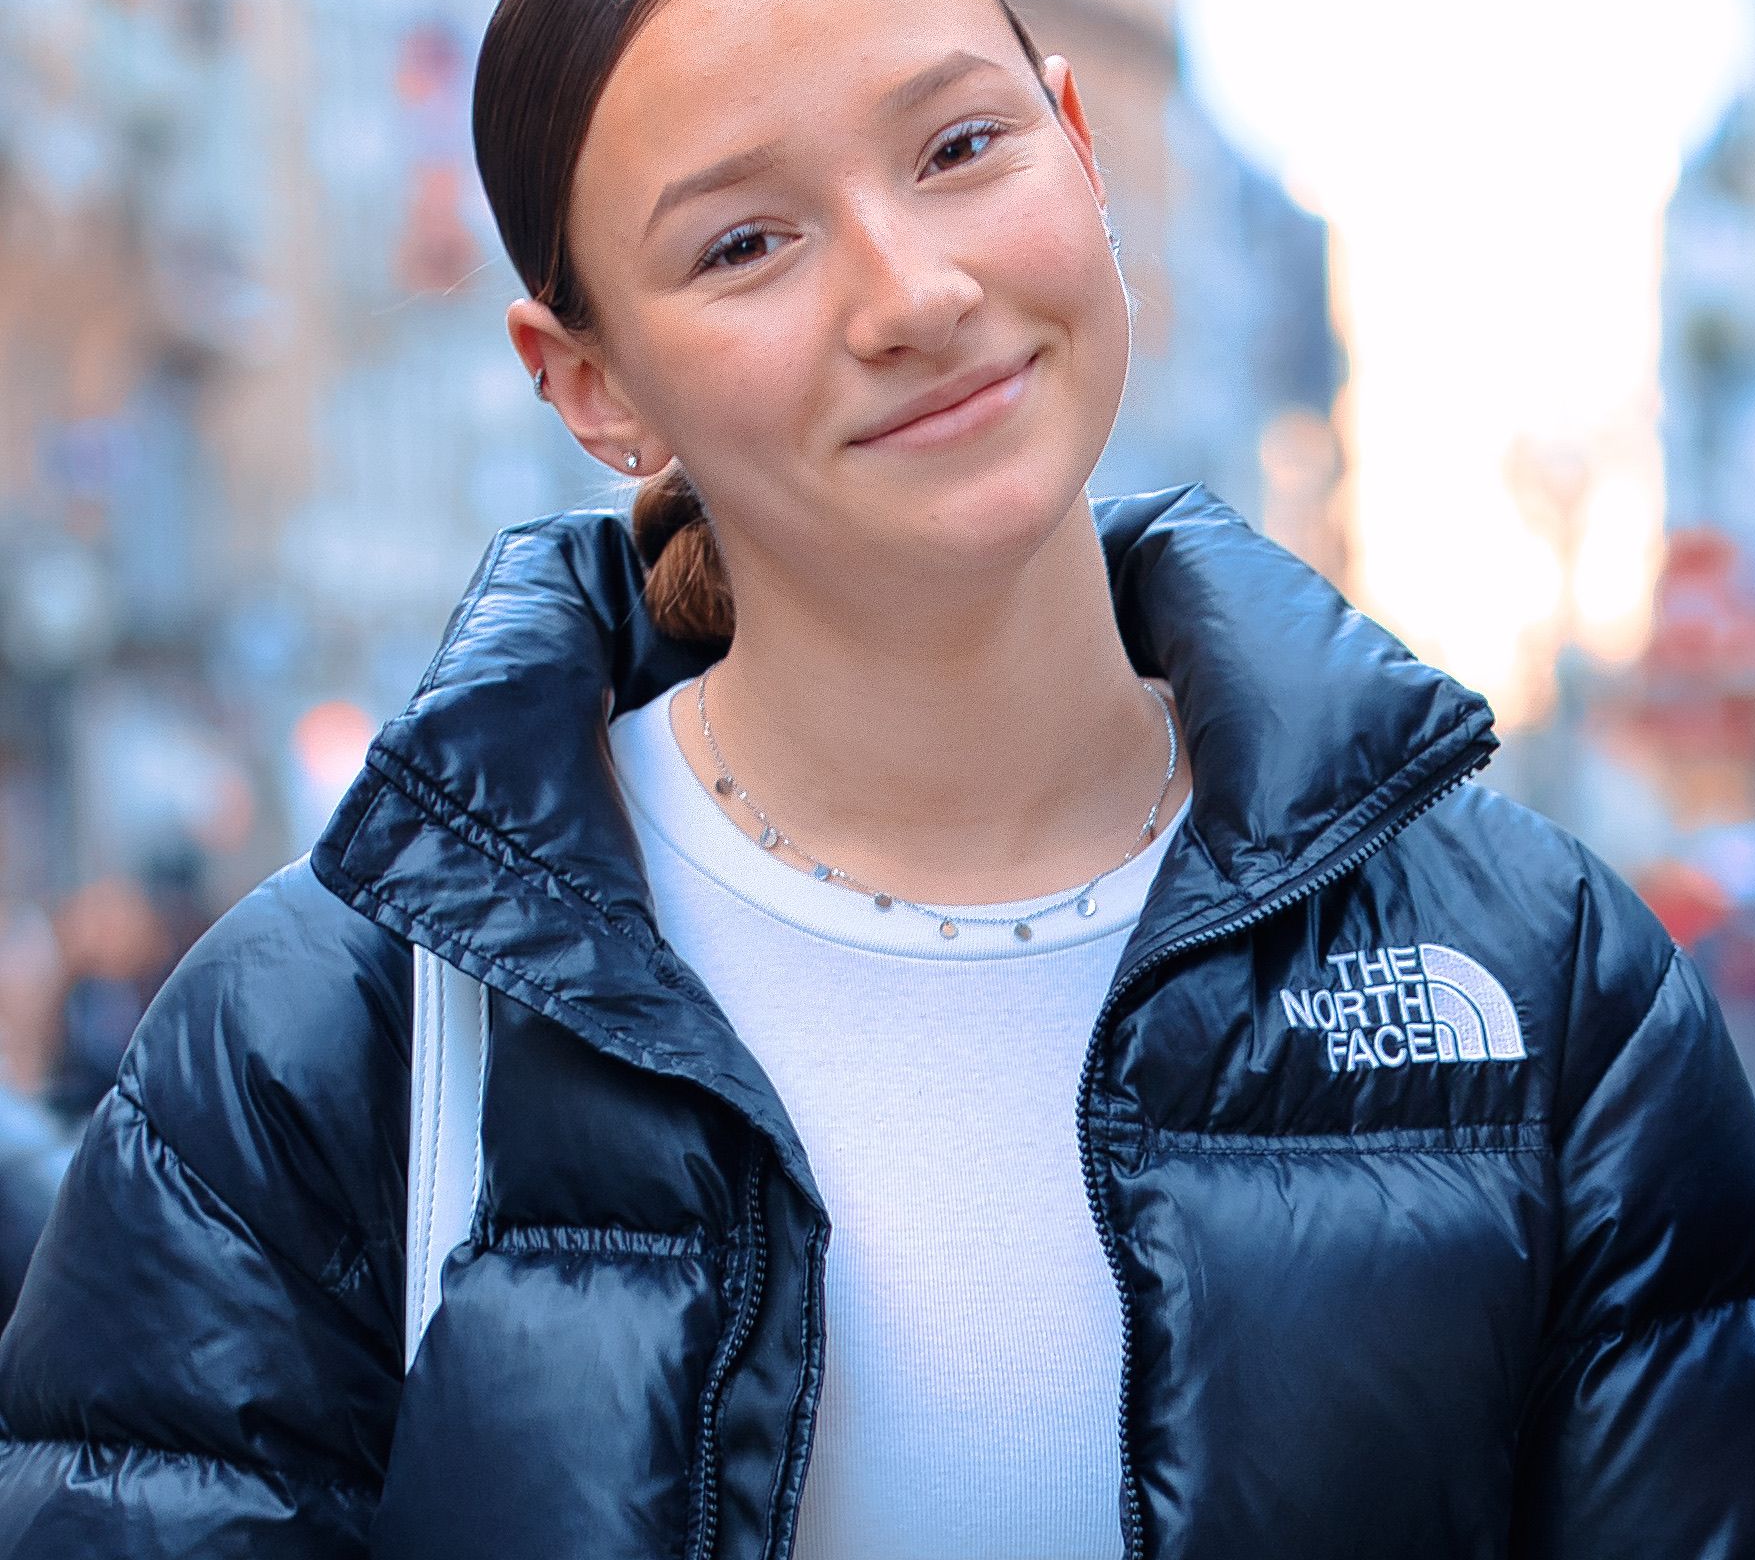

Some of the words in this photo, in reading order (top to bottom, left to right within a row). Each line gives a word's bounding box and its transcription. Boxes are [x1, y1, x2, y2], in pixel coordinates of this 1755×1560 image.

[1326, 945, 1425, 991] THE
[1279, 982, 1433, 1032] NORTH
[1327, 1022, 1439, 1073] FACE
